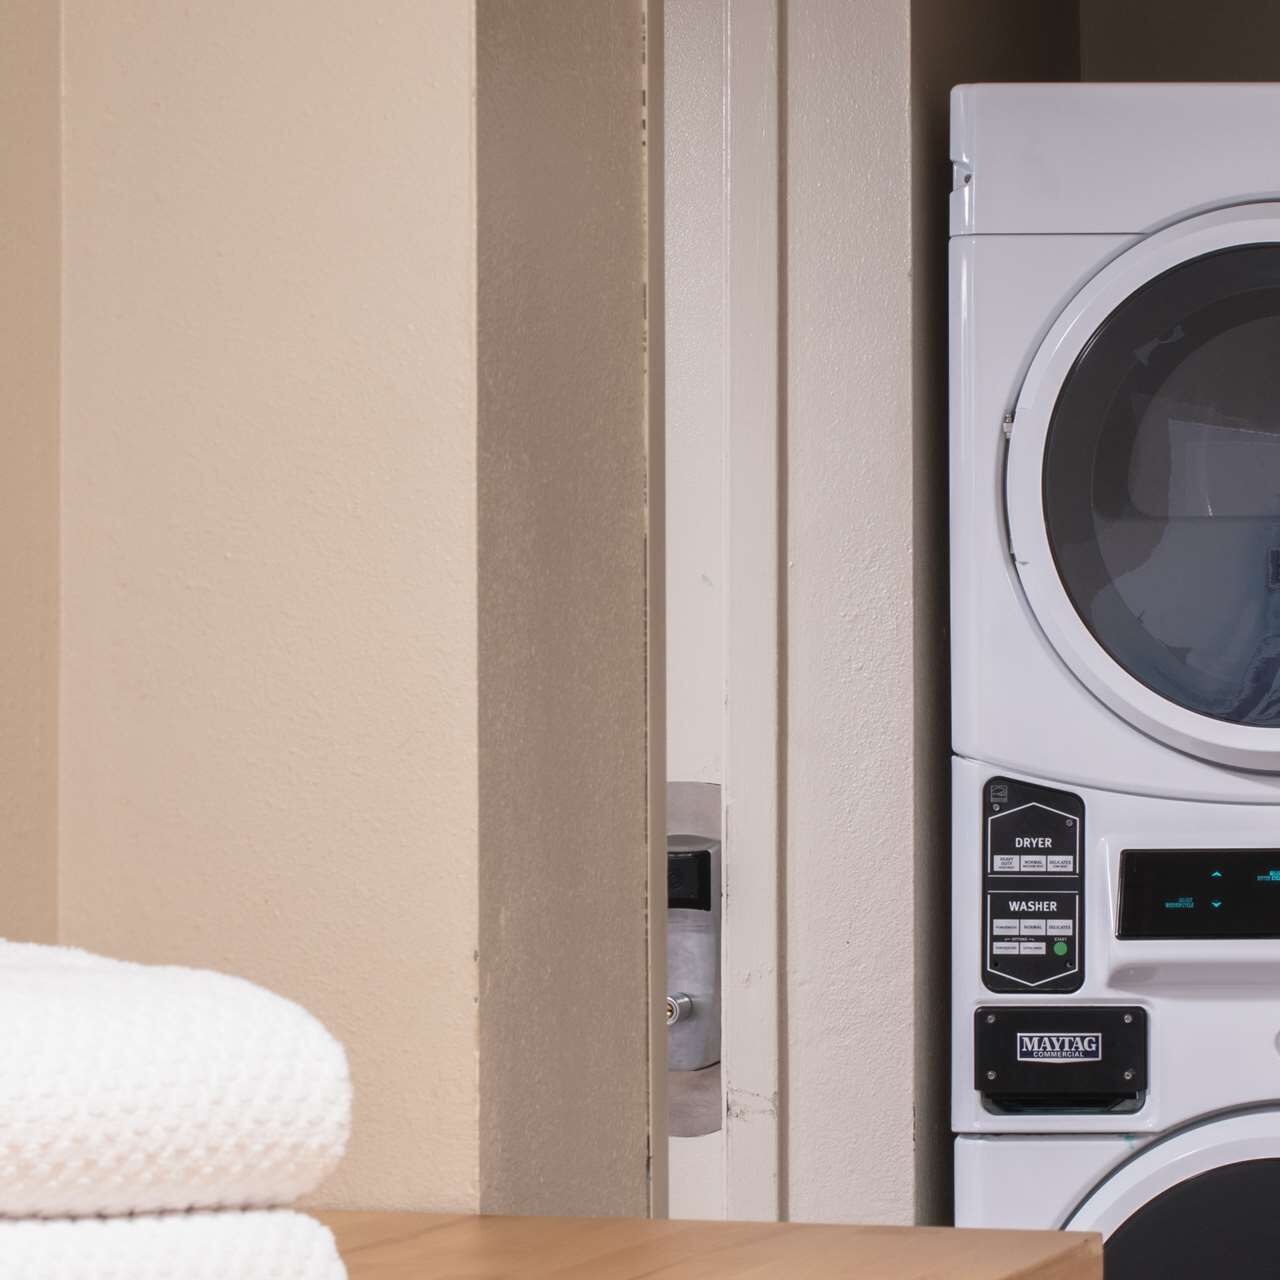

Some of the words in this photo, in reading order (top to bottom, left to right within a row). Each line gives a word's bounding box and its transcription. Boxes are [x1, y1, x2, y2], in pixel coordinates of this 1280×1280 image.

[1015, 837, 1053, 848] DRYER
[1008, 901, 1057, 912] WASHER
[1022, 1037, 1097, 1051] MAYTAG
